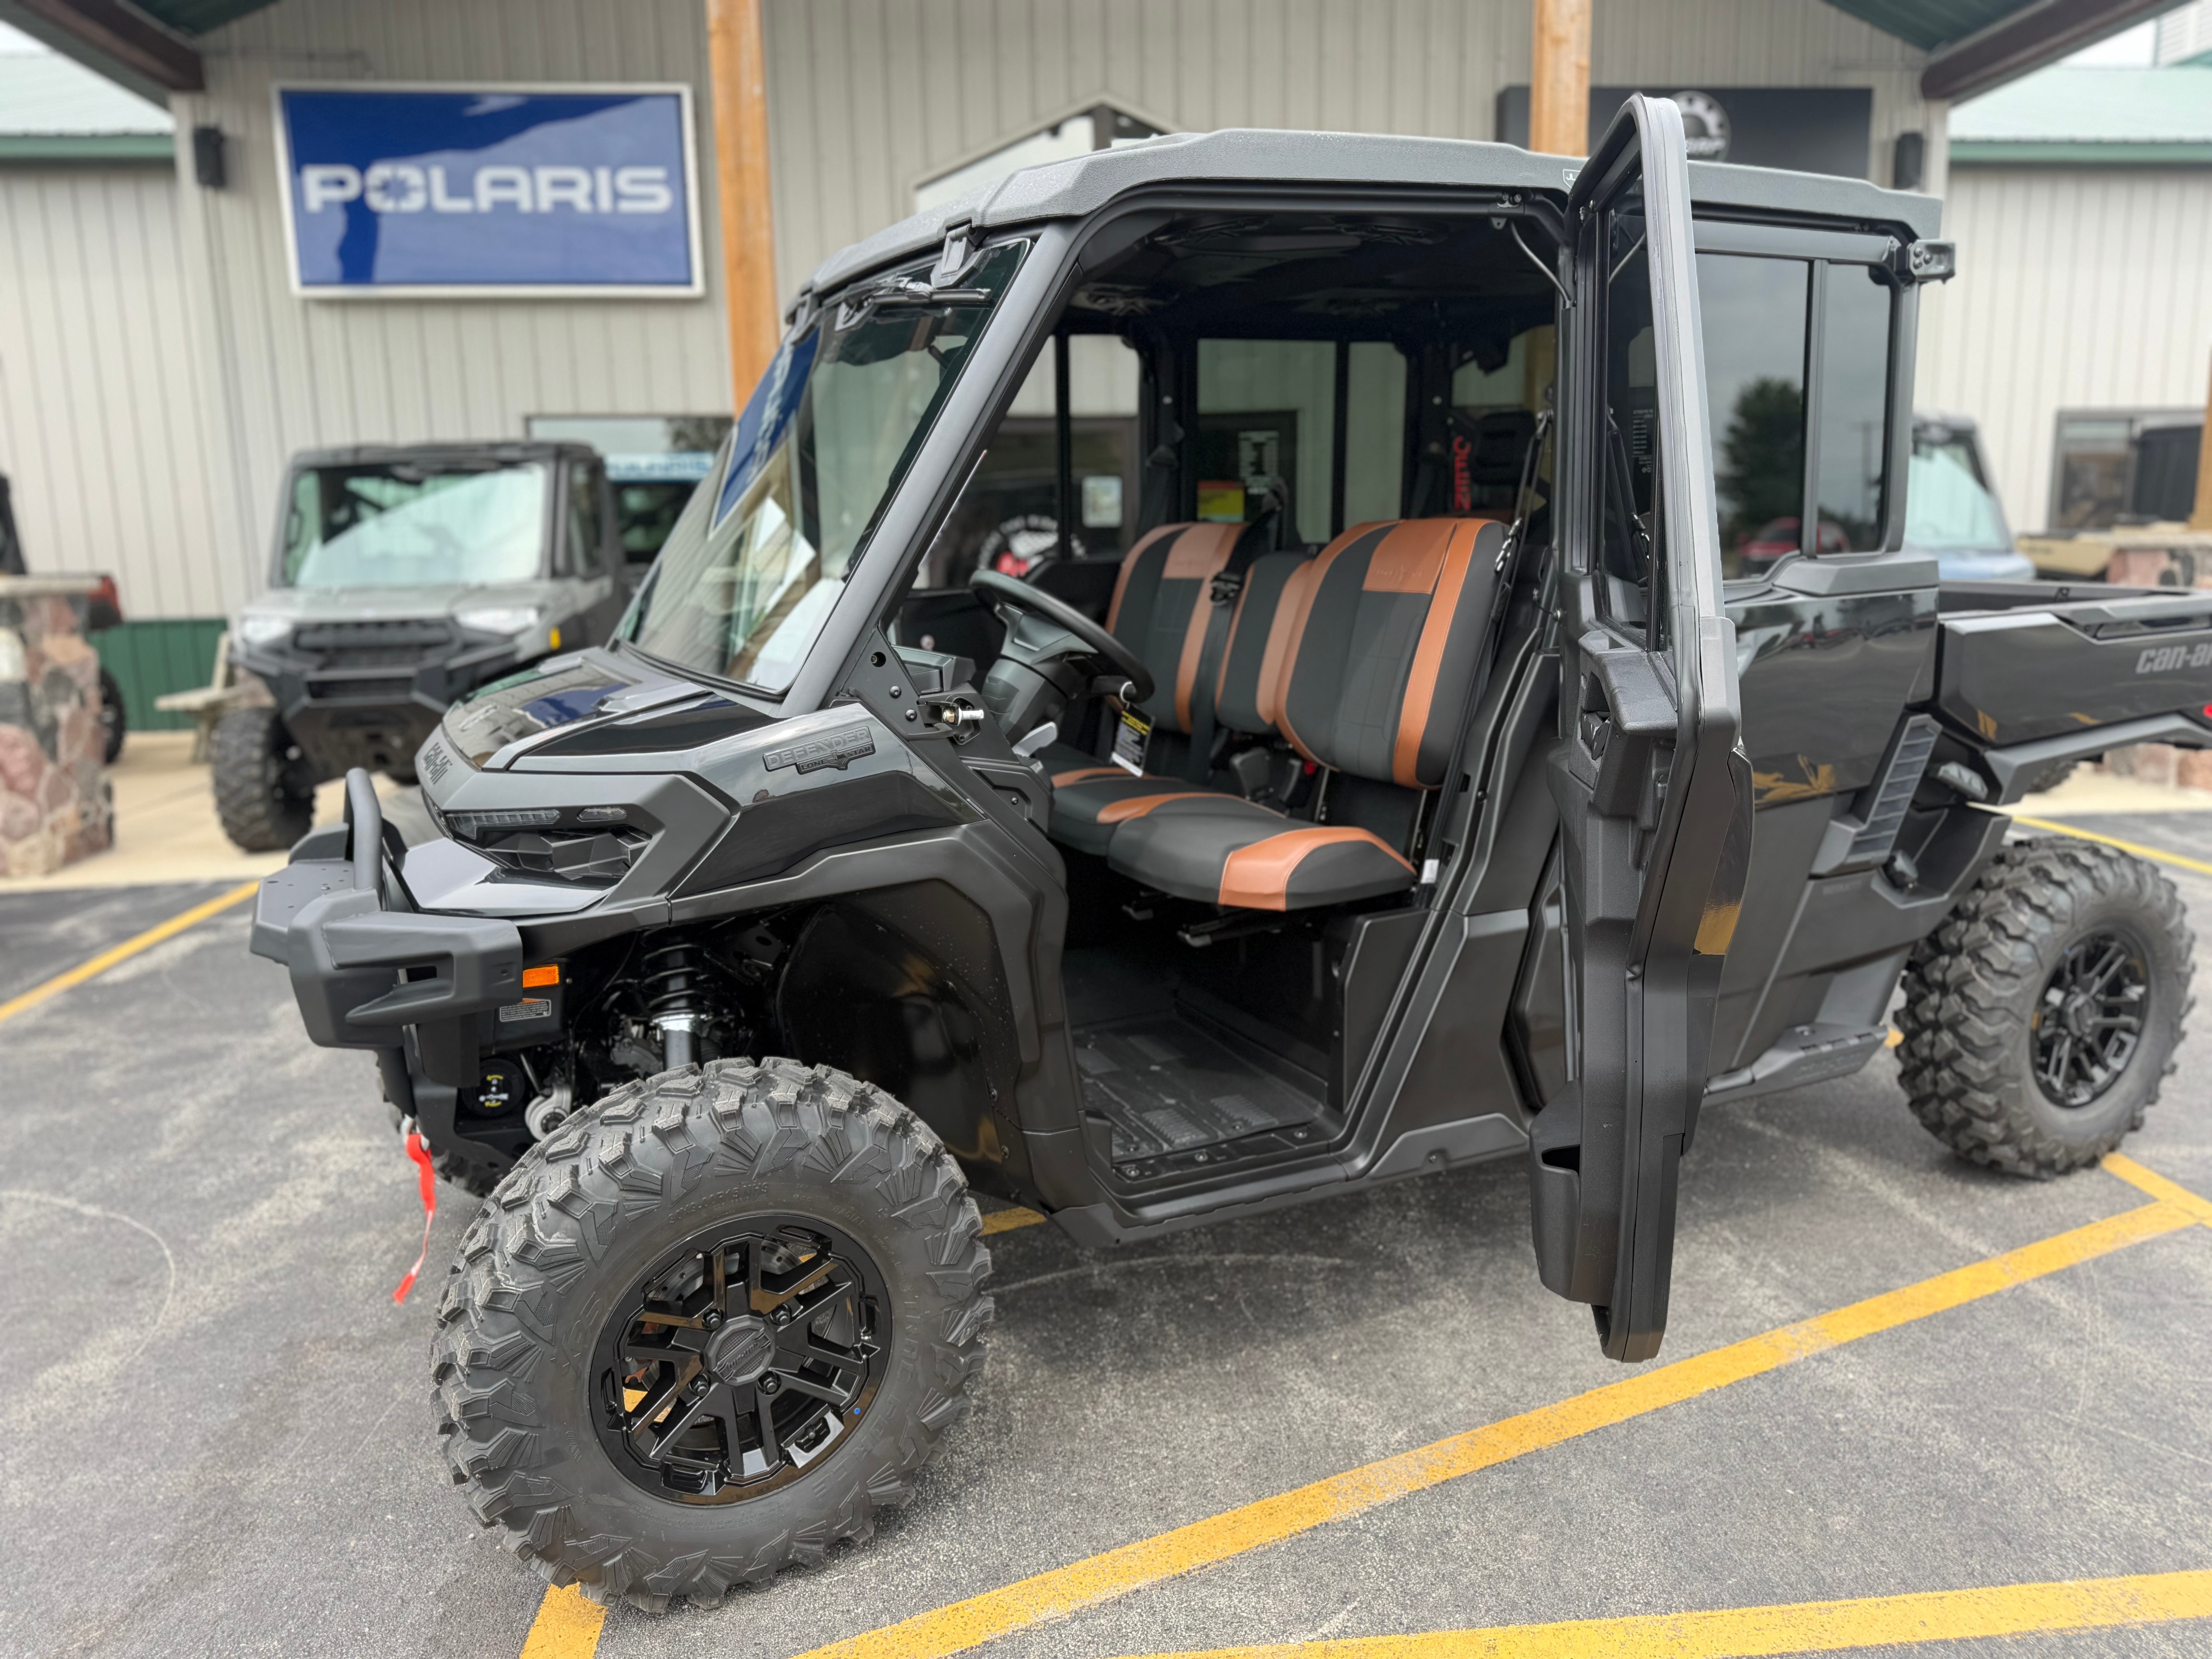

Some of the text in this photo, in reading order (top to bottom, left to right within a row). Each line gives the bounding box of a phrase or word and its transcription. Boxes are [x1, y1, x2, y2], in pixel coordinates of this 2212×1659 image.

[301, 165, 674, 215] POLARIS
[2135, 642, 2212, 675] can-a
[767, 729, 871, 768] DEFENDER
[801, 745, 871, 770] LONE STAR
